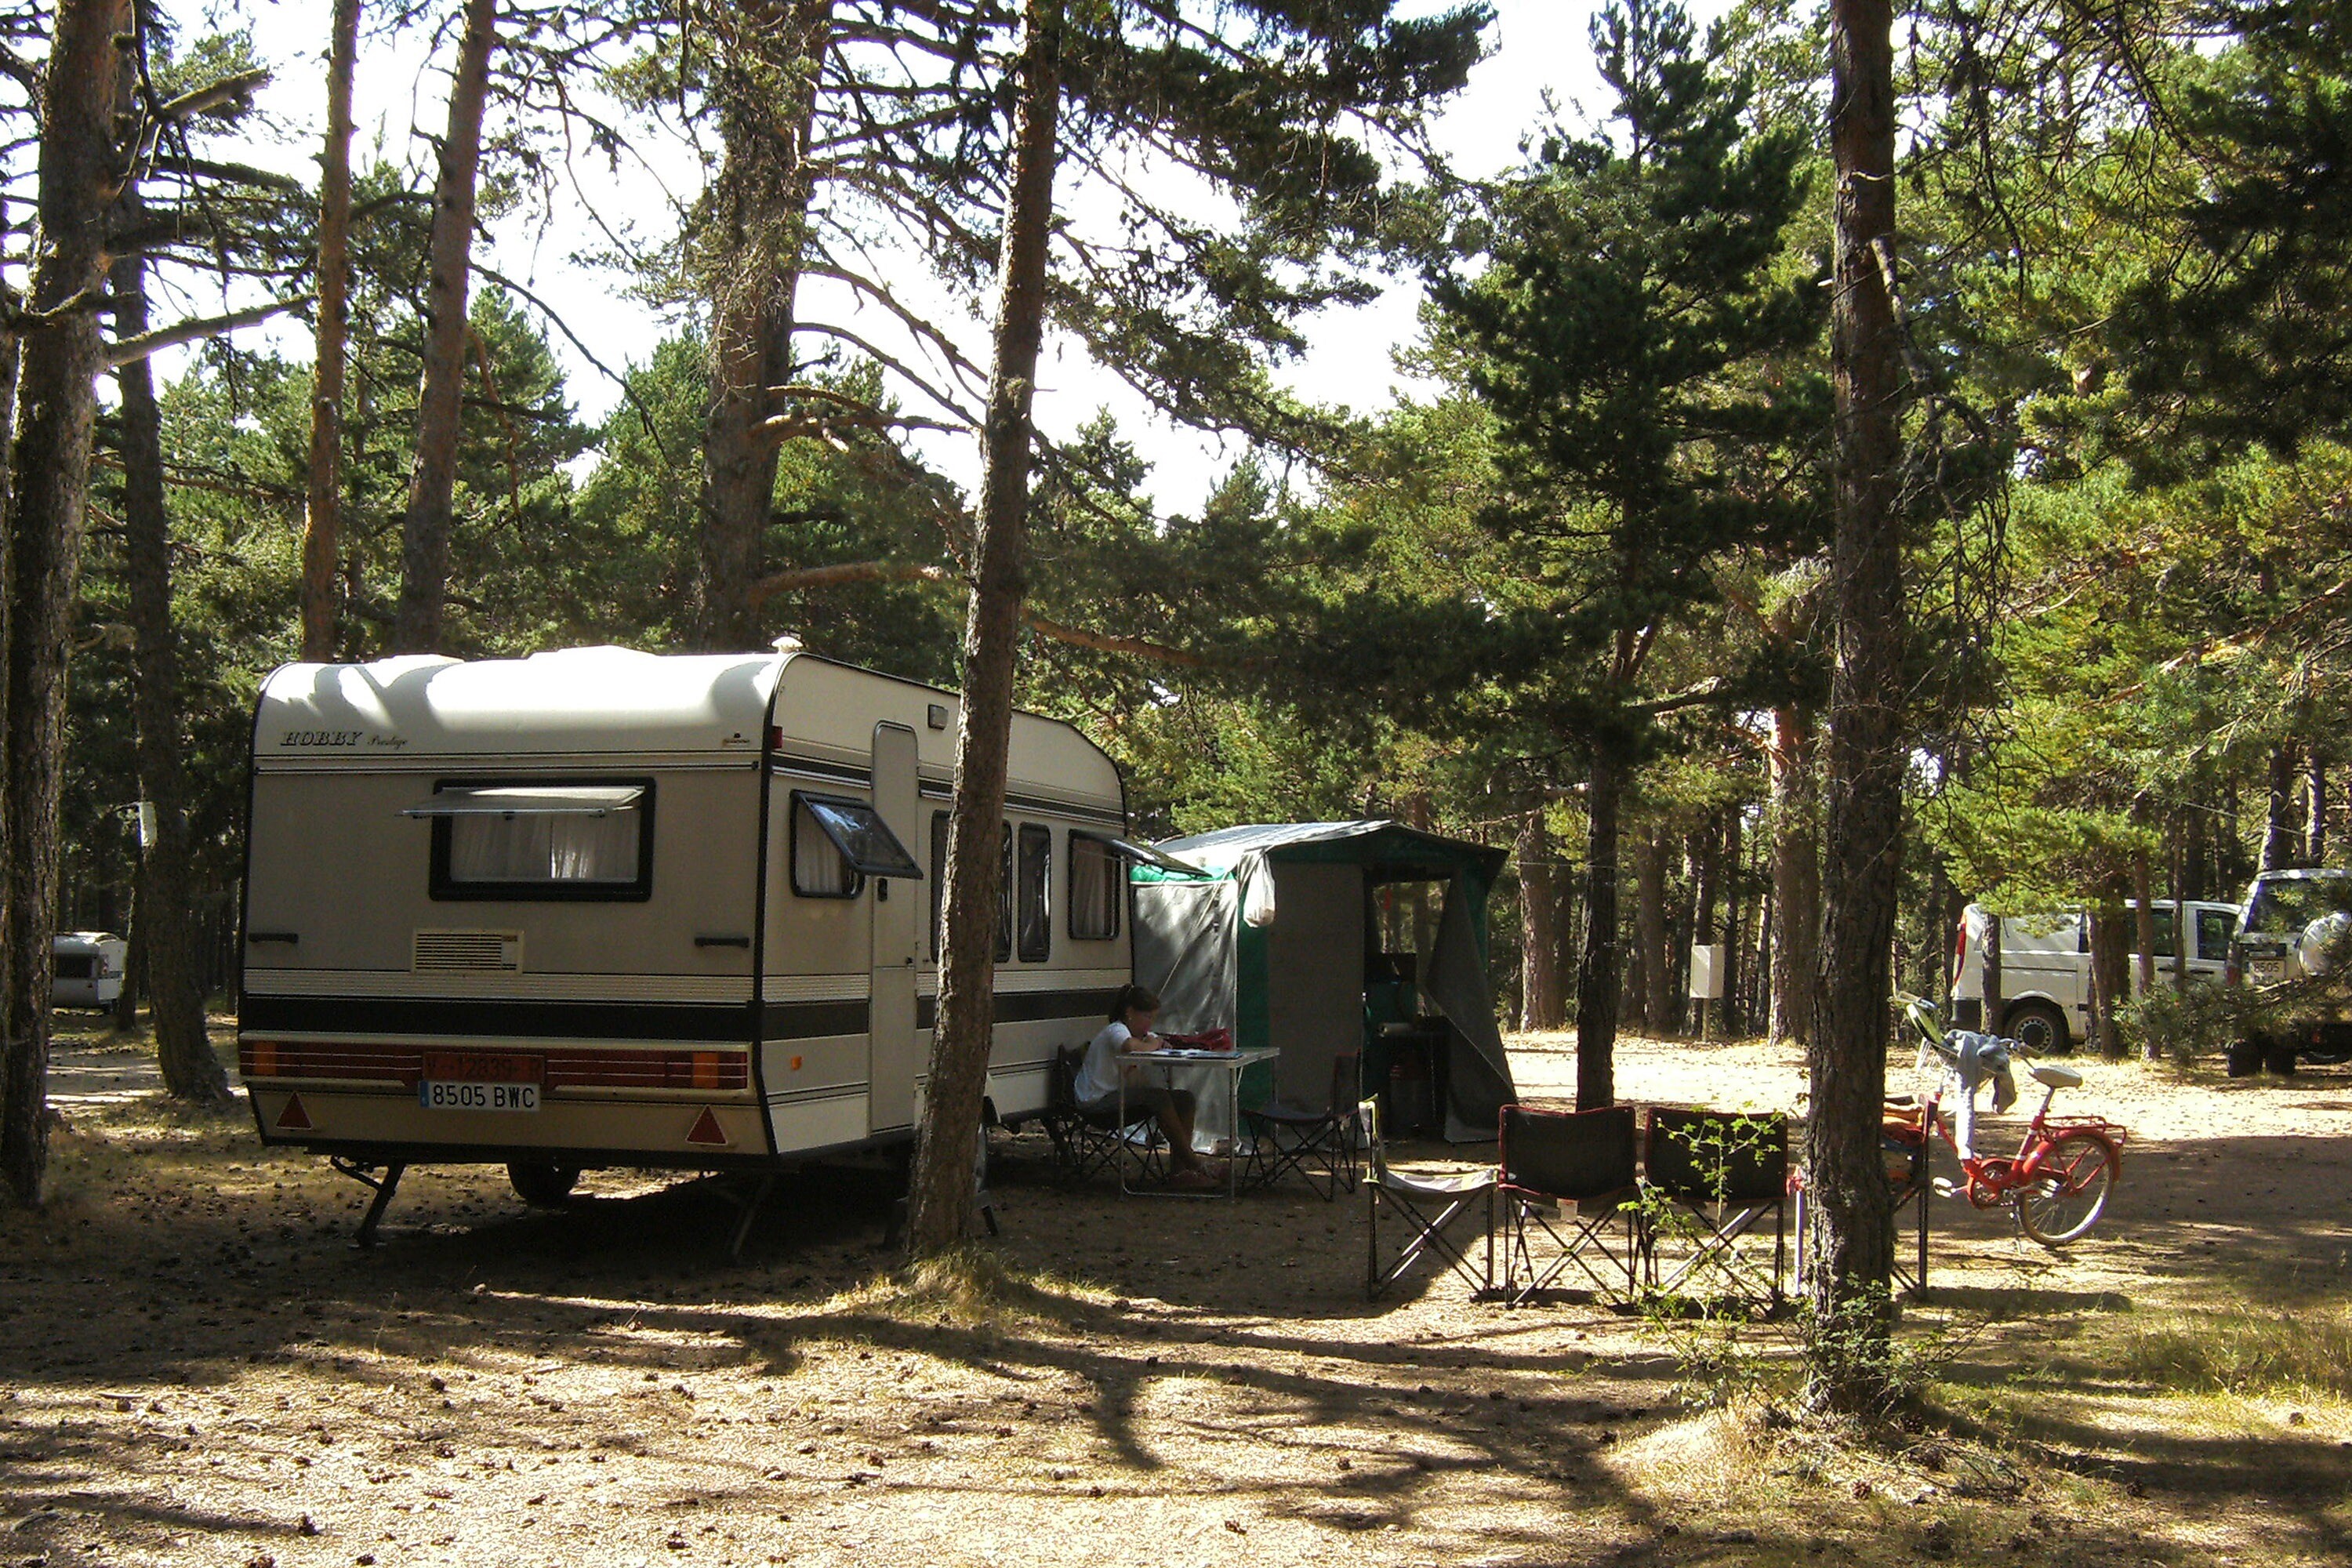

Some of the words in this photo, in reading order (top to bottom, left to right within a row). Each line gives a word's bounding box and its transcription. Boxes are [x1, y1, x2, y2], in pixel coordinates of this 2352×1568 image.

[280, 731, 363, 746] HOBBY
[434, 1084, 485, 1106] 8505
[494, 1087, 534, 1108] BWC
